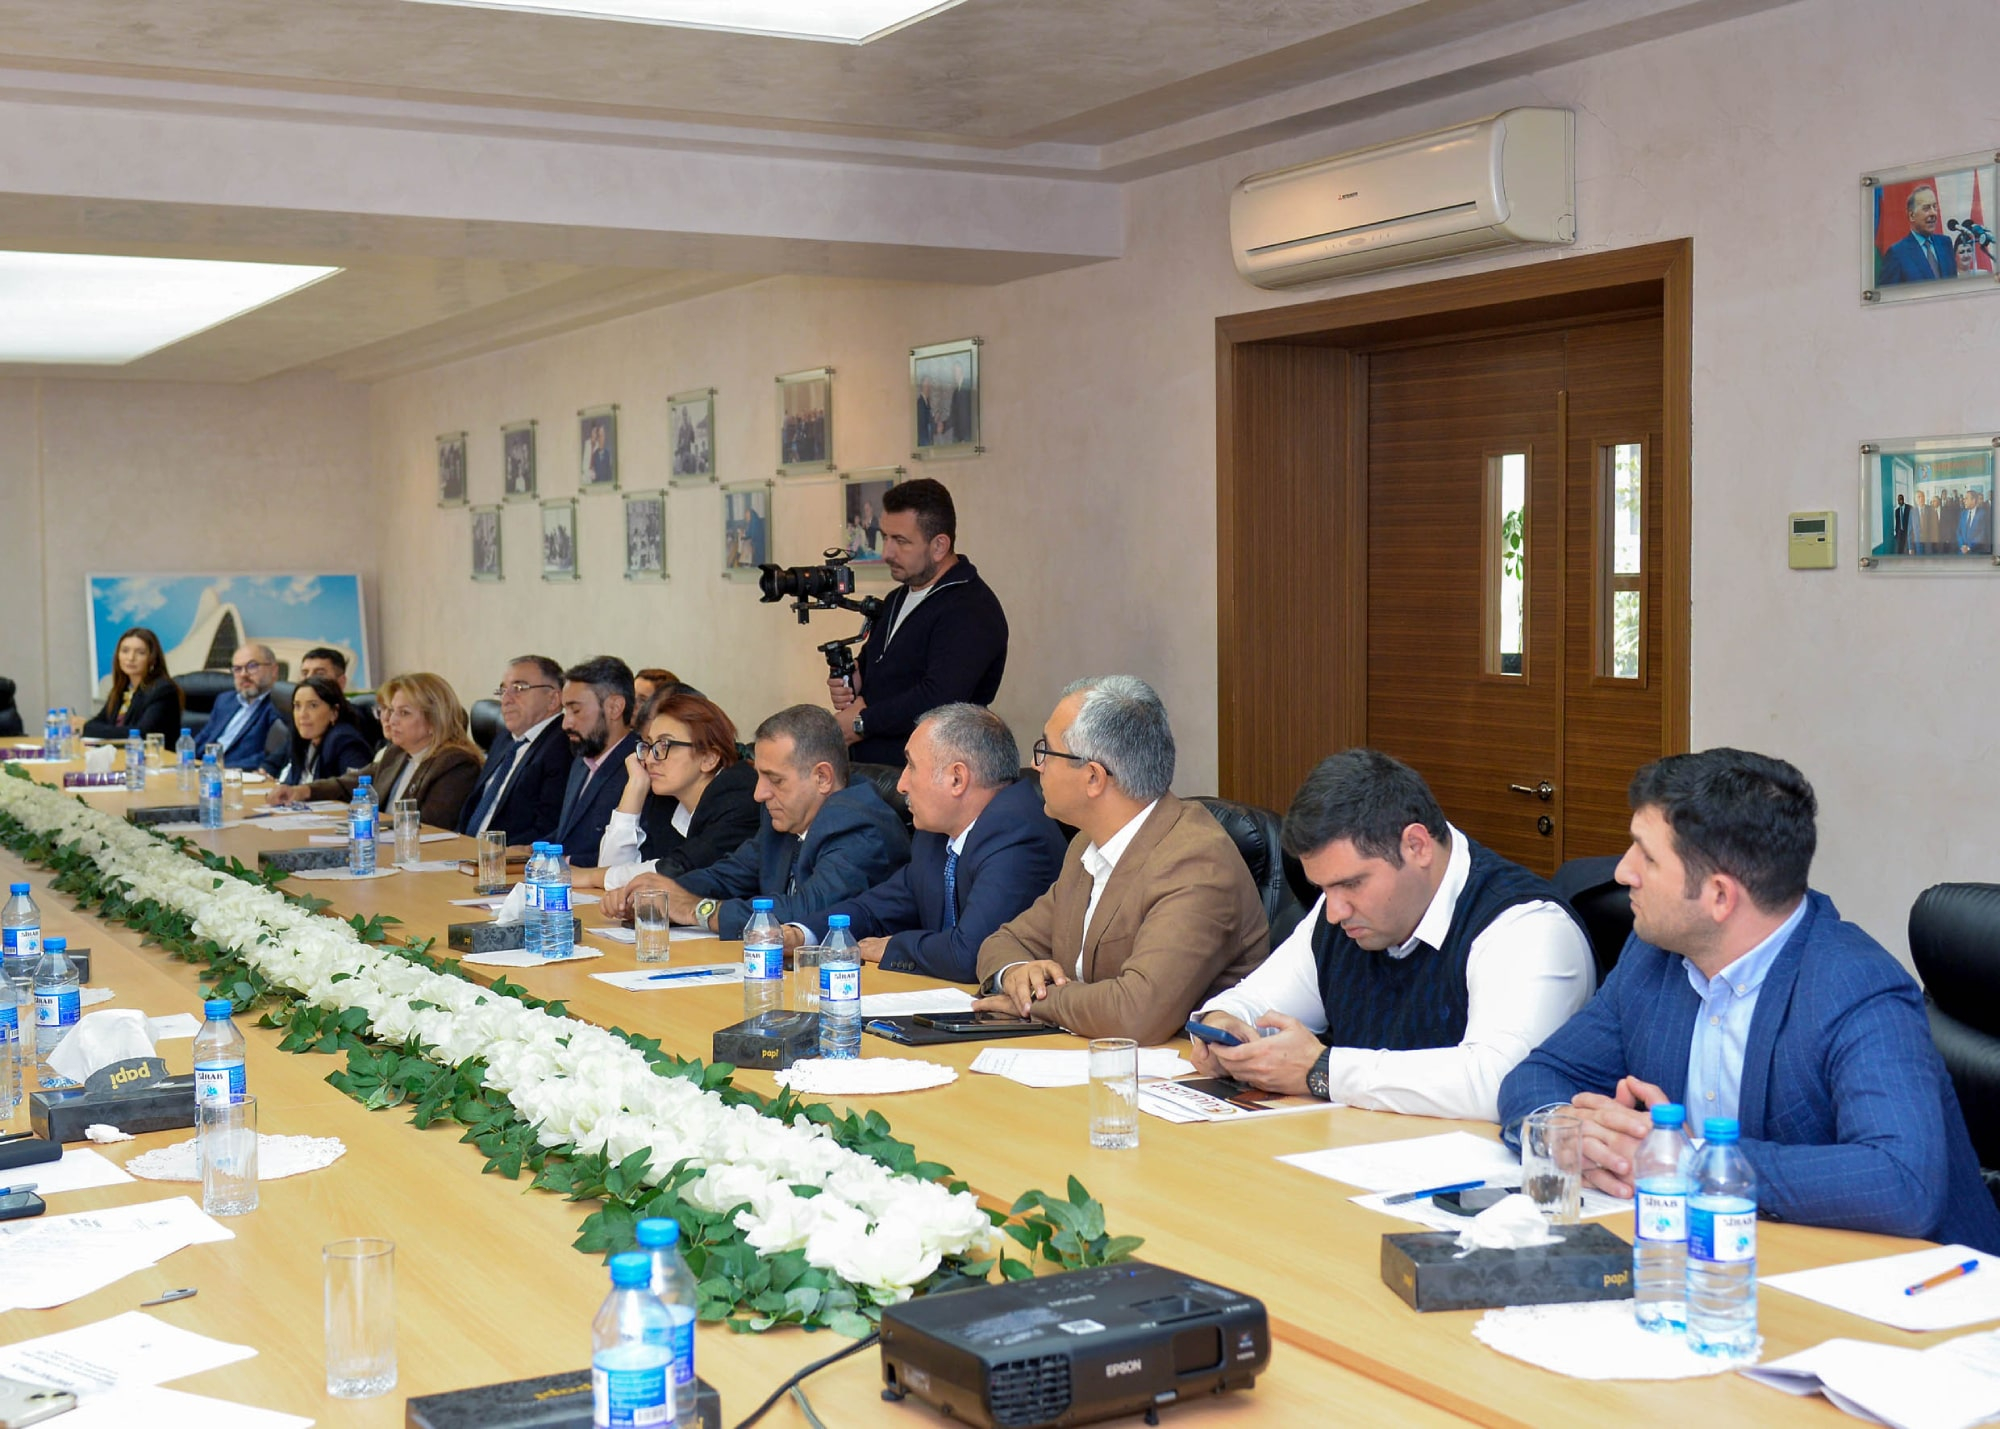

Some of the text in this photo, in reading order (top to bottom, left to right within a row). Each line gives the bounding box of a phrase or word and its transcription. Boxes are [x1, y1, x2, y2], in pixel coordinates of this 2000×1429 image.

[109, 1061, 151, 1090] papi
[1603, 1270, 1628, 1288] papi
[1106, 1359, 1142, 1378] EPSON
